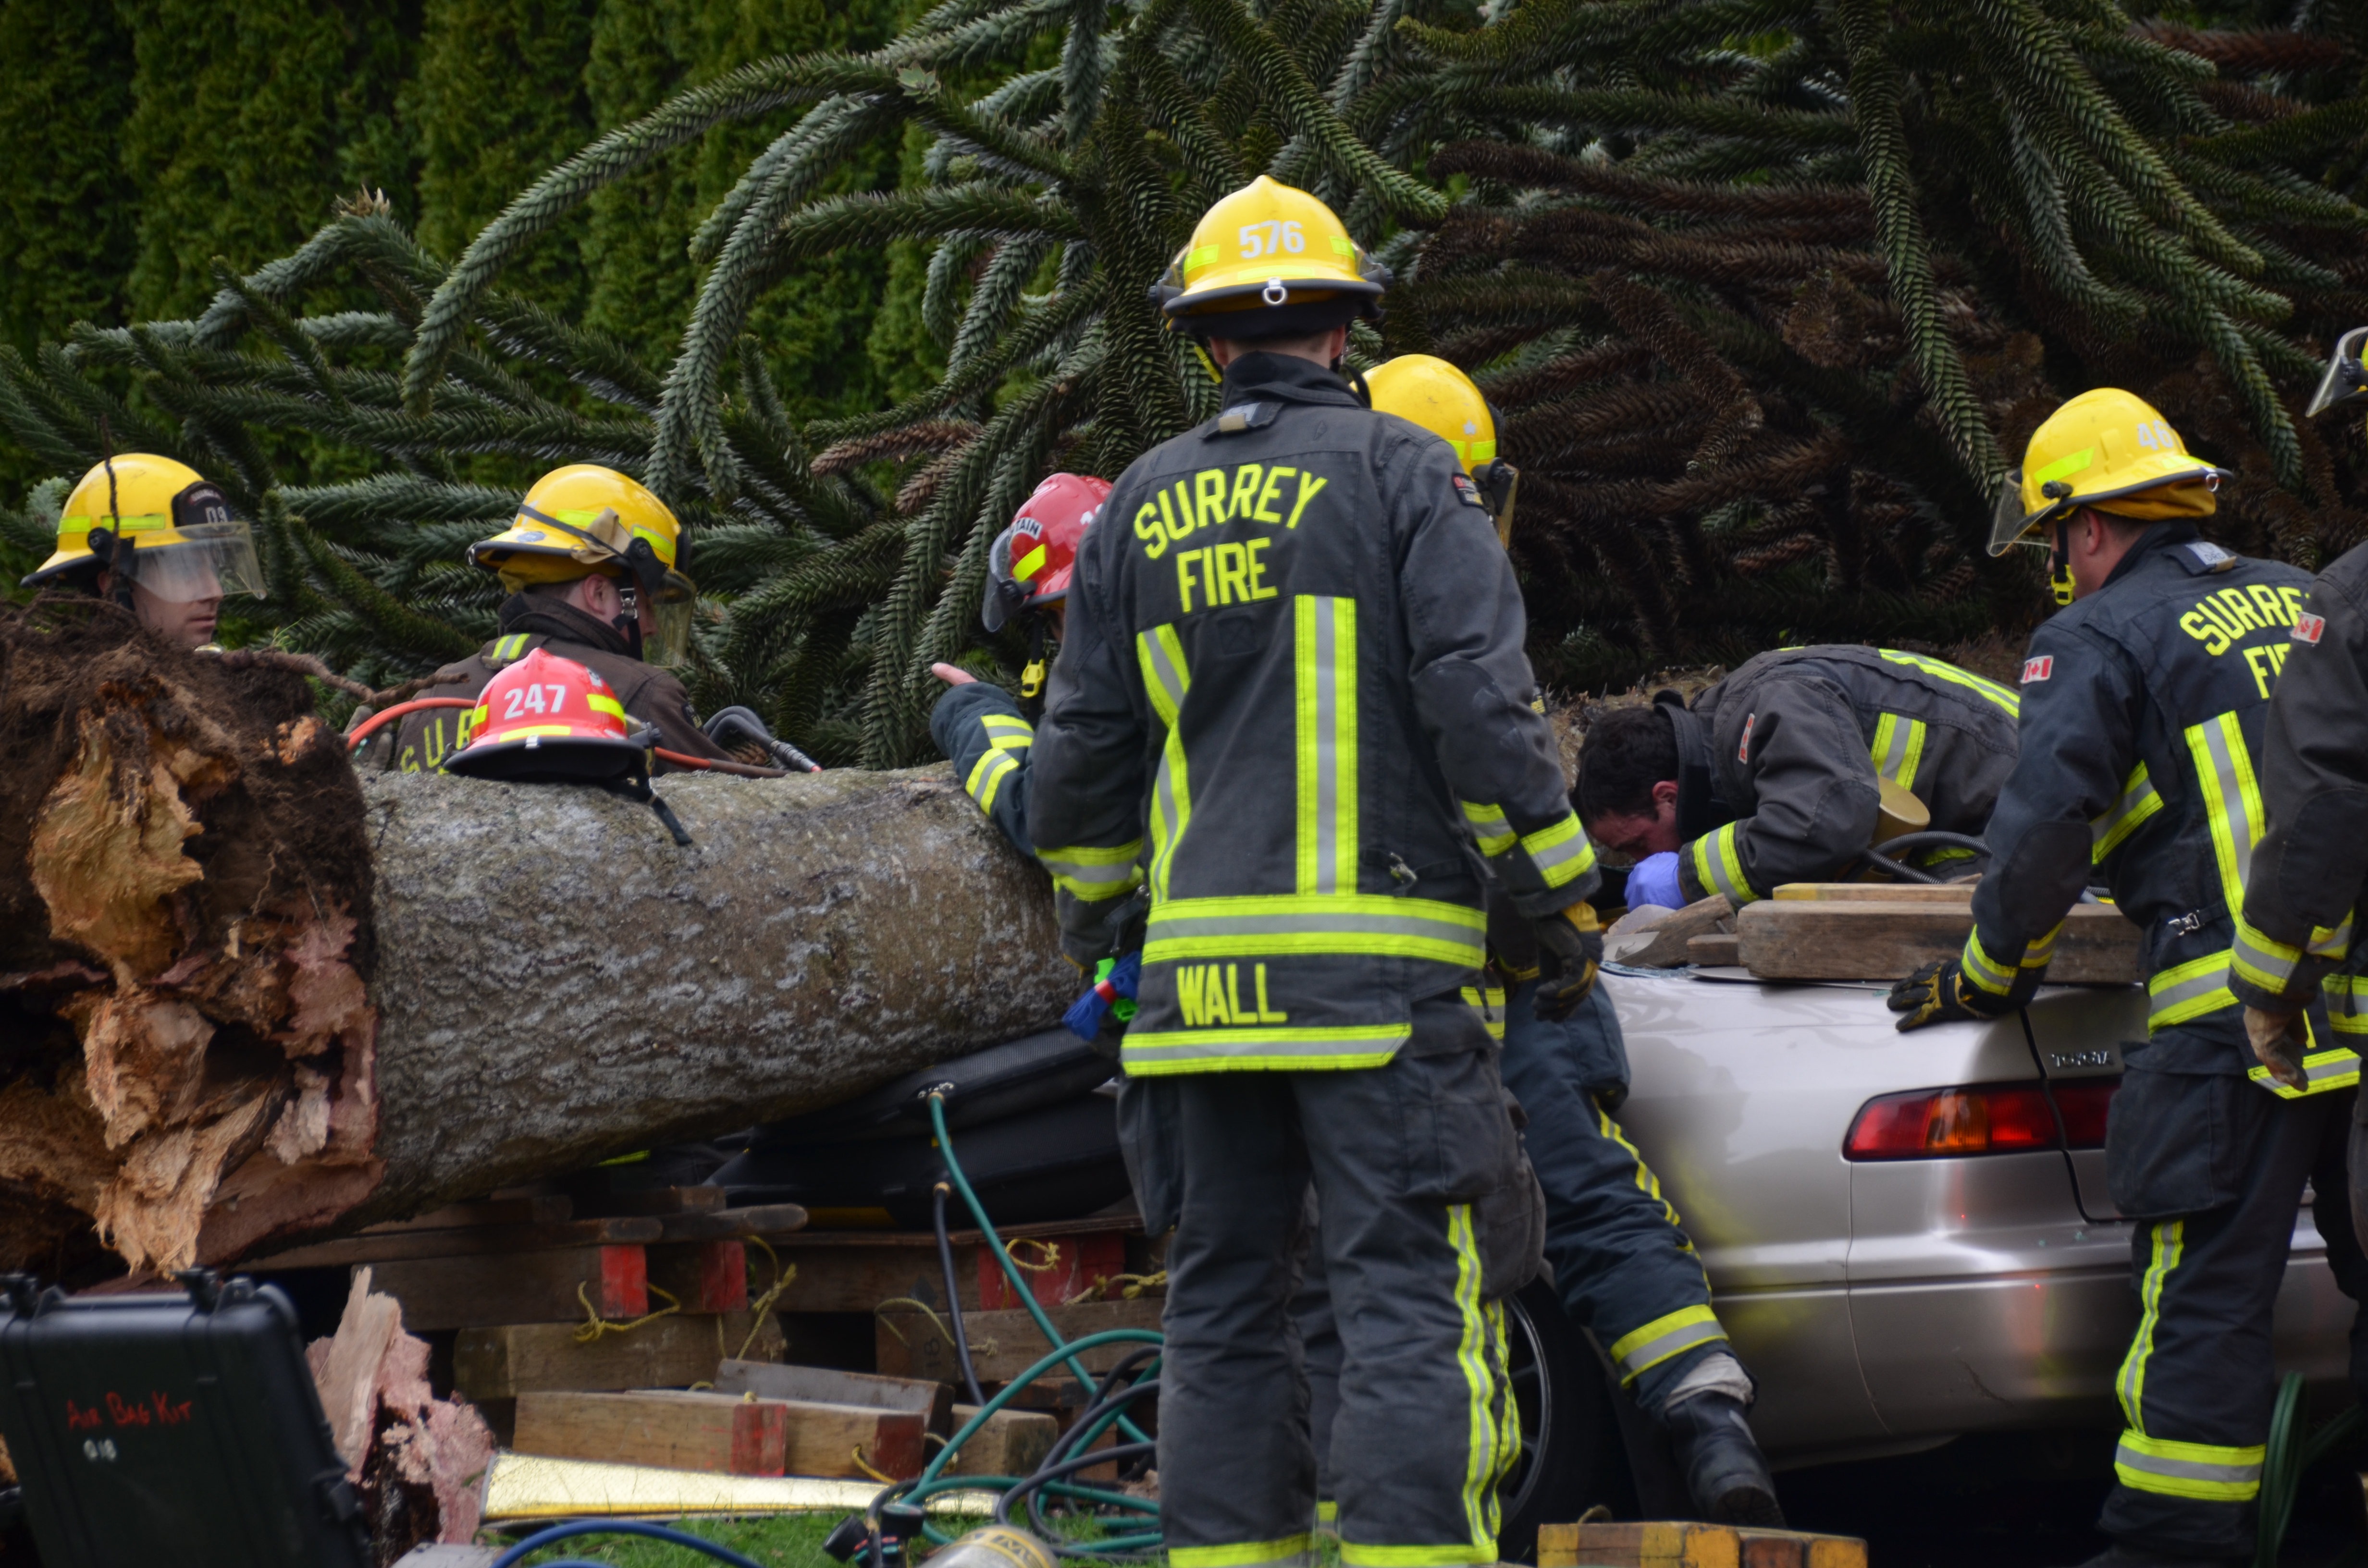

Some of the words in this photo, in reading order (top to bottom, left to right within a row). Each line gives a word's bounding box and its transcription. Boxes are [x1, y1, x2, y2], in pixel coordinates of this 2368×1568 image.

[1239, 220, 1306, 259] 576
[1134, 464, 1328, 559] SURREY
[1176, 537, 1278, 613] FIRE
[2180, 584, 2310, 656] SURRE
[504, 684, 566, 721] 247
[1176, 962, 1289, 1027] WALL
[2050, 1050, 2112, 1067] TOYOTA
